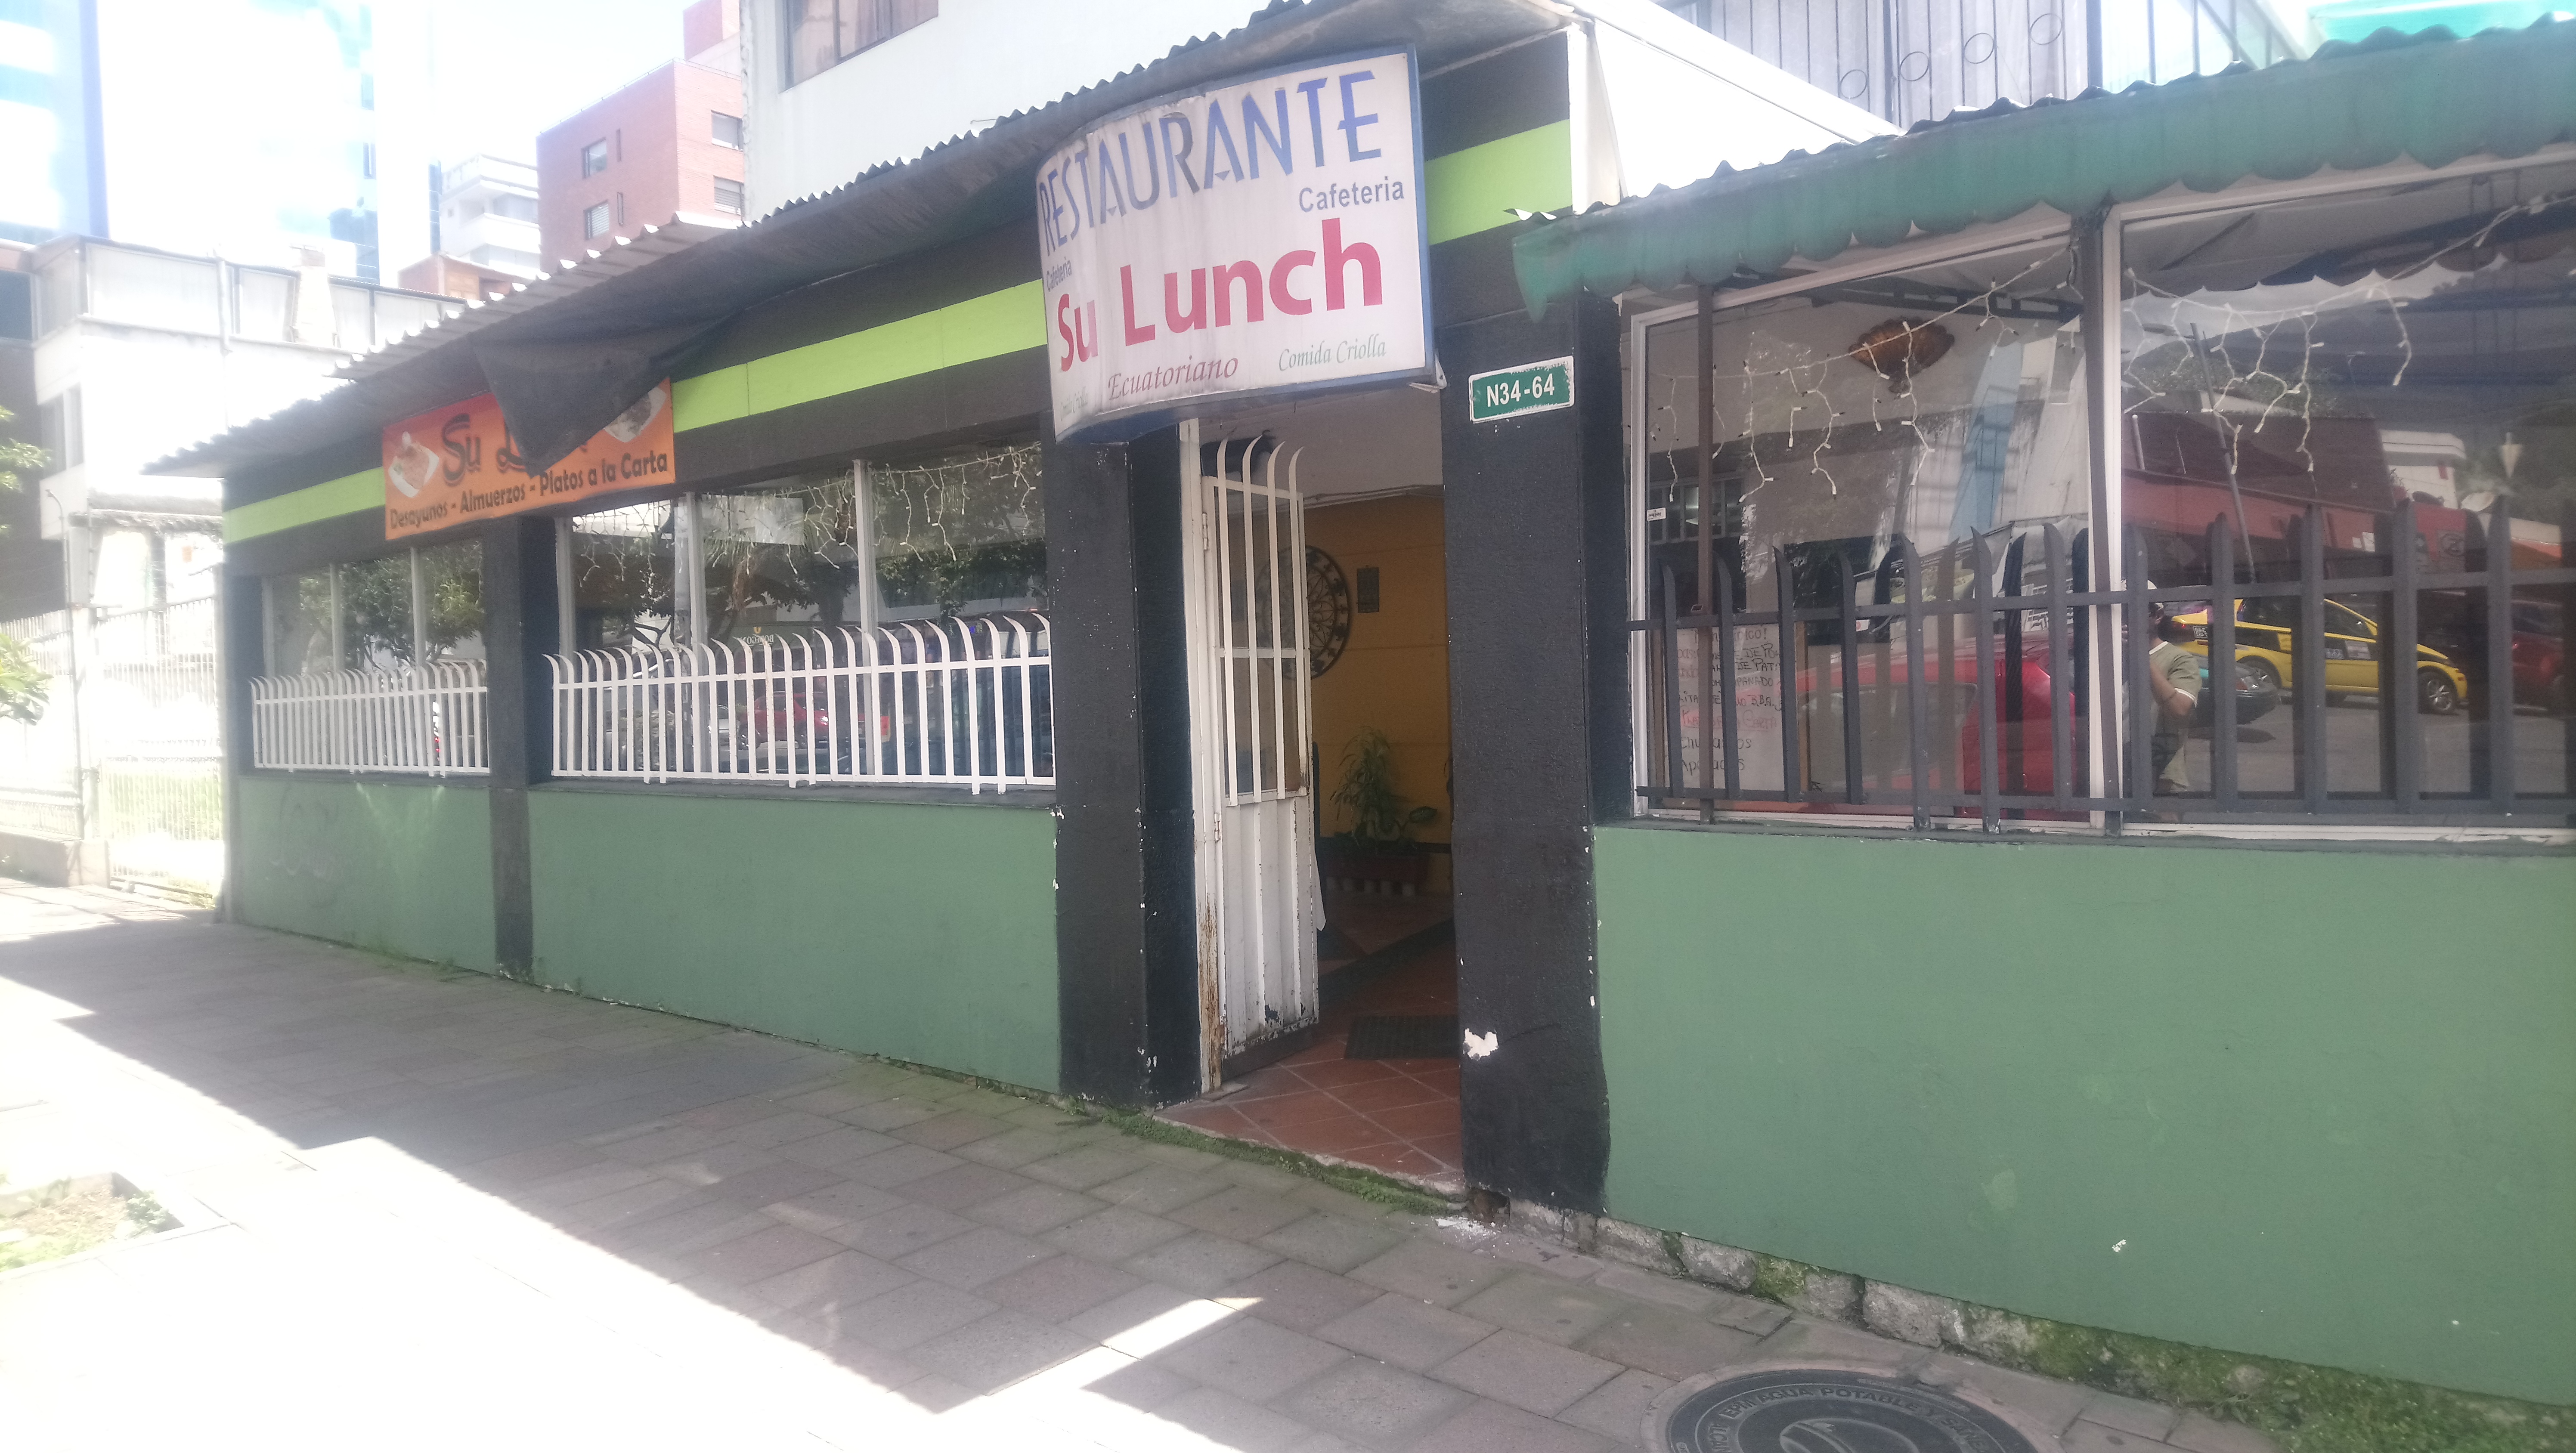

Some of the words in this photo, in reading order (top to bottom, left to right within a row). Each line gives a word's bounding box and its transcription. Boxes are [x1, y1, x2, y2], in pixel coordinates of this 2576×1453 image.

[1039, 70, 1382, 257] RESTAURANTE
[1299, 176, 1405, 213] Cafeteria
[1046, 257, 1072, 292] Cafeteria
[1057, 293, 1098, 372] Su
[1120, 217, 1383, 346] Lunch
[1279, 340, 1332, 372] Comida
[1336, 333, 1387, 364] Criolla
[1108, 355, 1238, 400] Ecuatoriano
[1486, 373, 1555, 408] N34-64
[441, 413, 482, 486] Su
[390, 501, 448, 529] Desayunos
[459, 483, 526, 513] Almuerzos
[539, 469, 583, 496] Platos
[588, 468, 598, 486] a
[601, 458, 616, 484] la
[621, 450, 667, 479] Carta
[1757, 1388, 1813, 1404] AGUA
[1820, 1387, 1923, 1411] POTABLE
